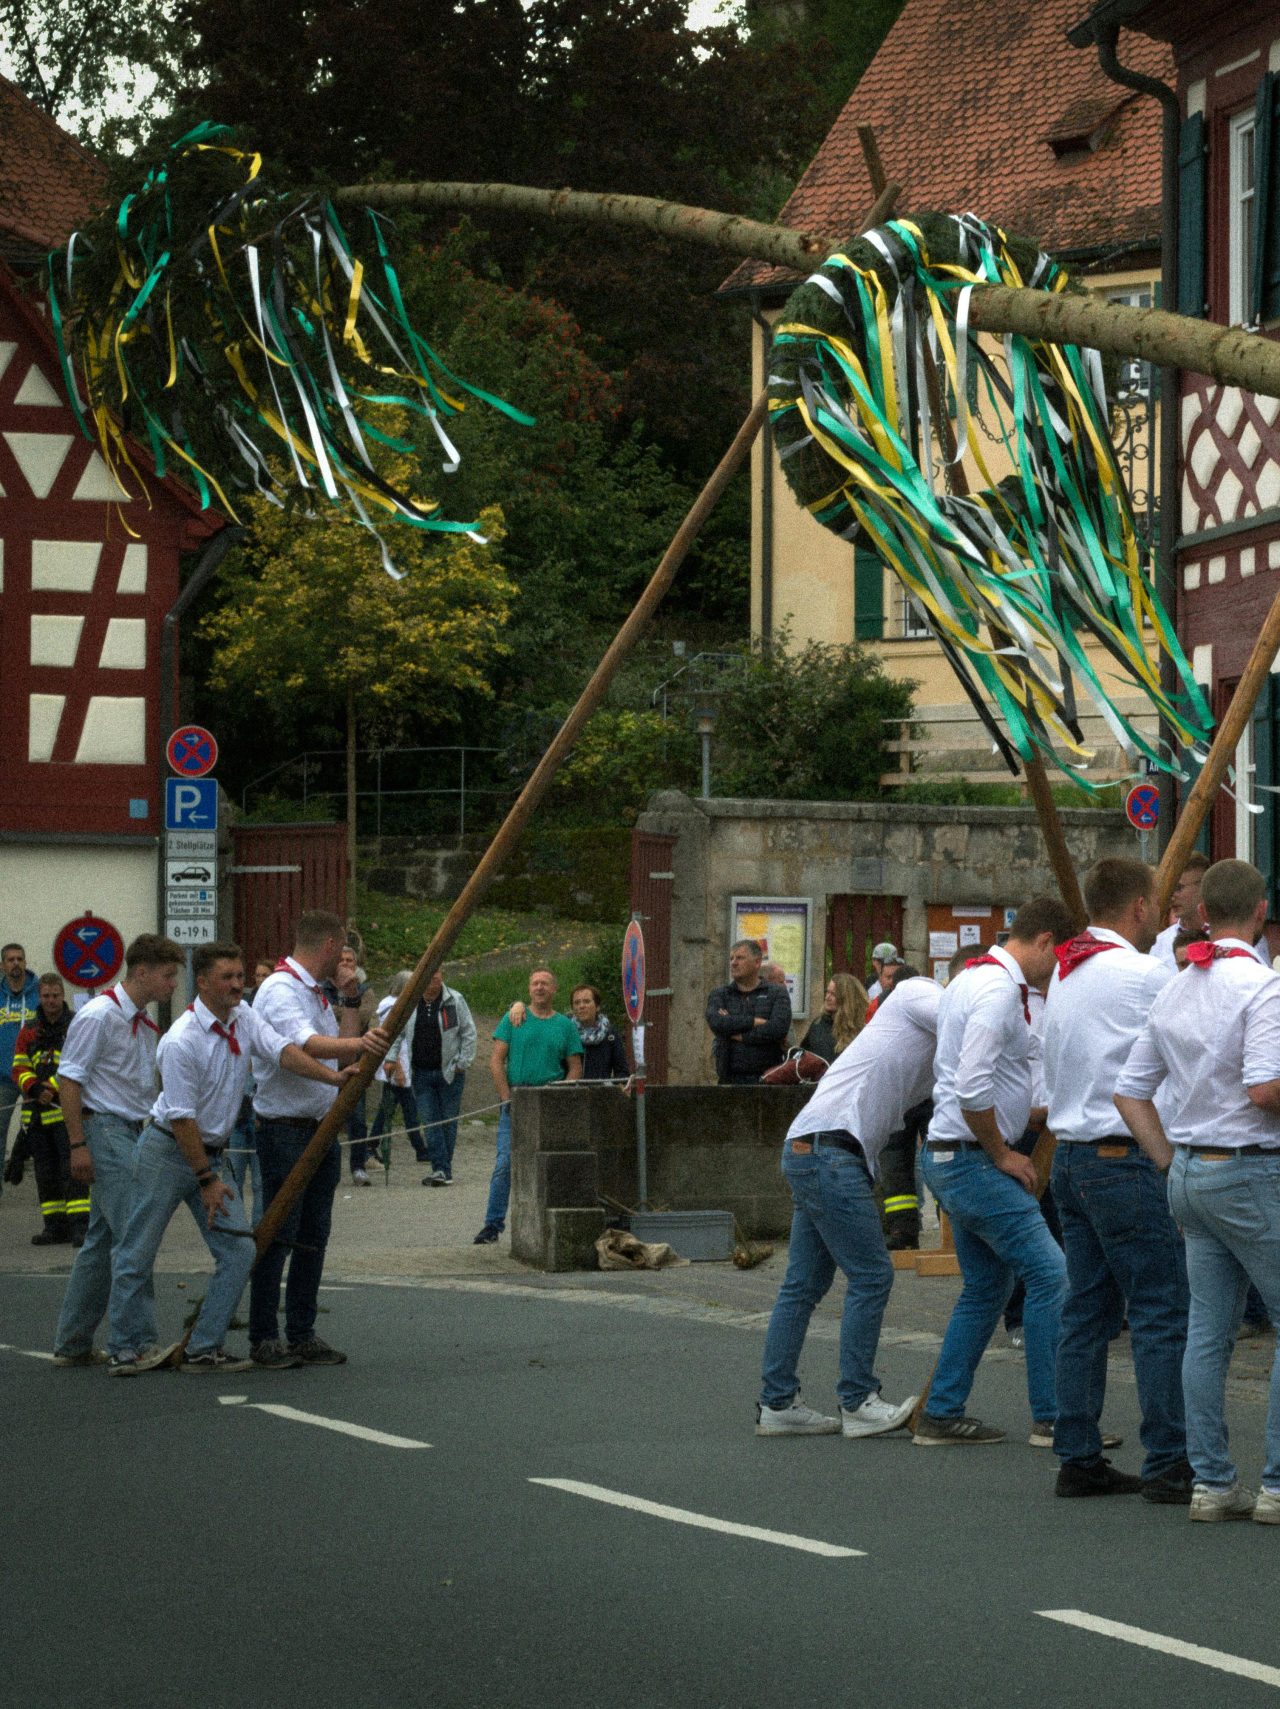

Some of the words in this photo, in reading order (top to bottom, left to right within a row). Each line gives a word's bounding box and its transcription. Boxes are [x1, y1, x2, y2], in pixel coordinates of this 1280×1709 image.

[175, 785, 202, 823] P
[176, 840, 214, 851] Stellplätze
[174, 926, 199, 938] 8-19
[202, 926, 208, 937] h
